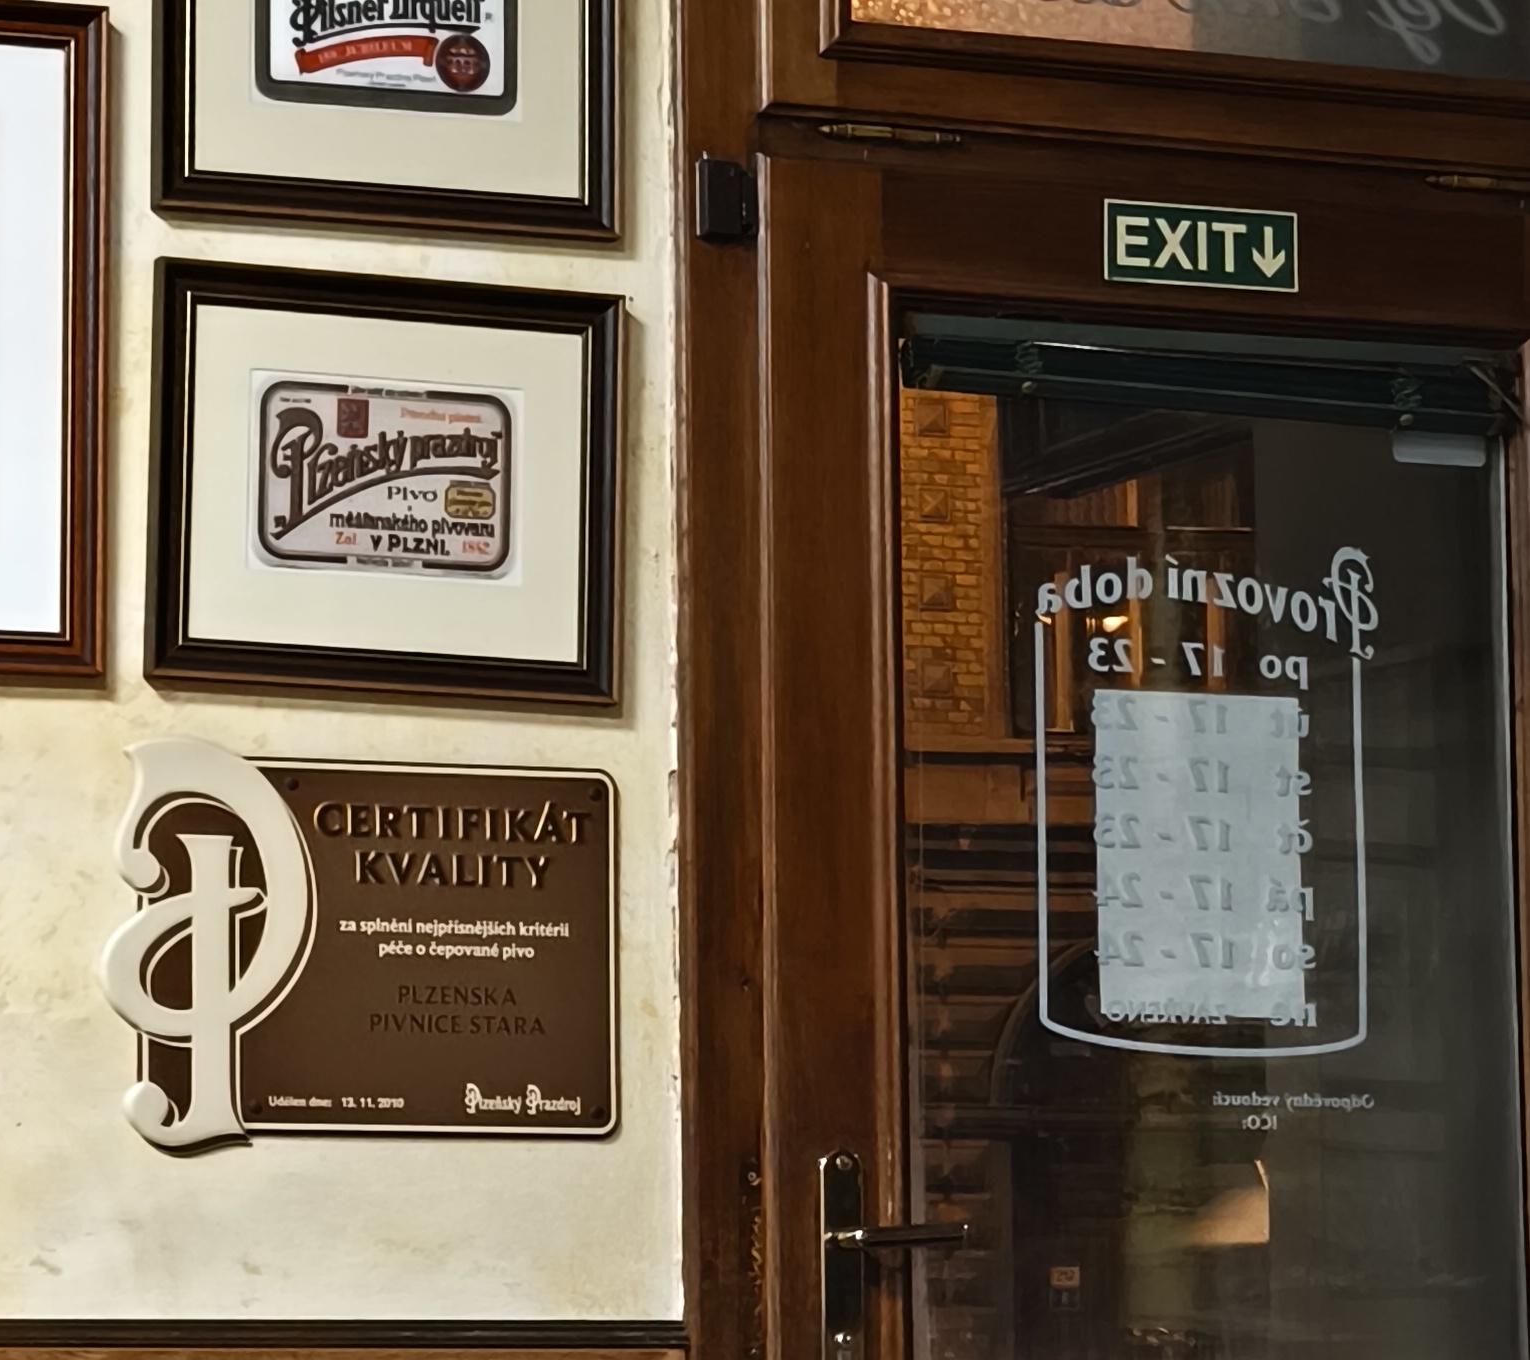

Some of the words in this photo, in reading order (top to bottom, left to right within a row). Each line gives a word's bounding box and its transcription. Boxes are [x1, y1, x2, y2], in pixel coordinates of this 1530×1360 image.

[1115, 215, 1248, 273] EXIT
[313, 800, 593, 845] CERTIFIKÁT
[355, 849, 552, 889] KVALITY
[340, 920, 357, 932] za
[379, 940, 413, 958] péče
[416, 944, 426, 956] o
[429, 941, 499, 960] čepované
[502, 943, 535, 961] pivo
[370, 1014, 463, 1034] PIVNICE
